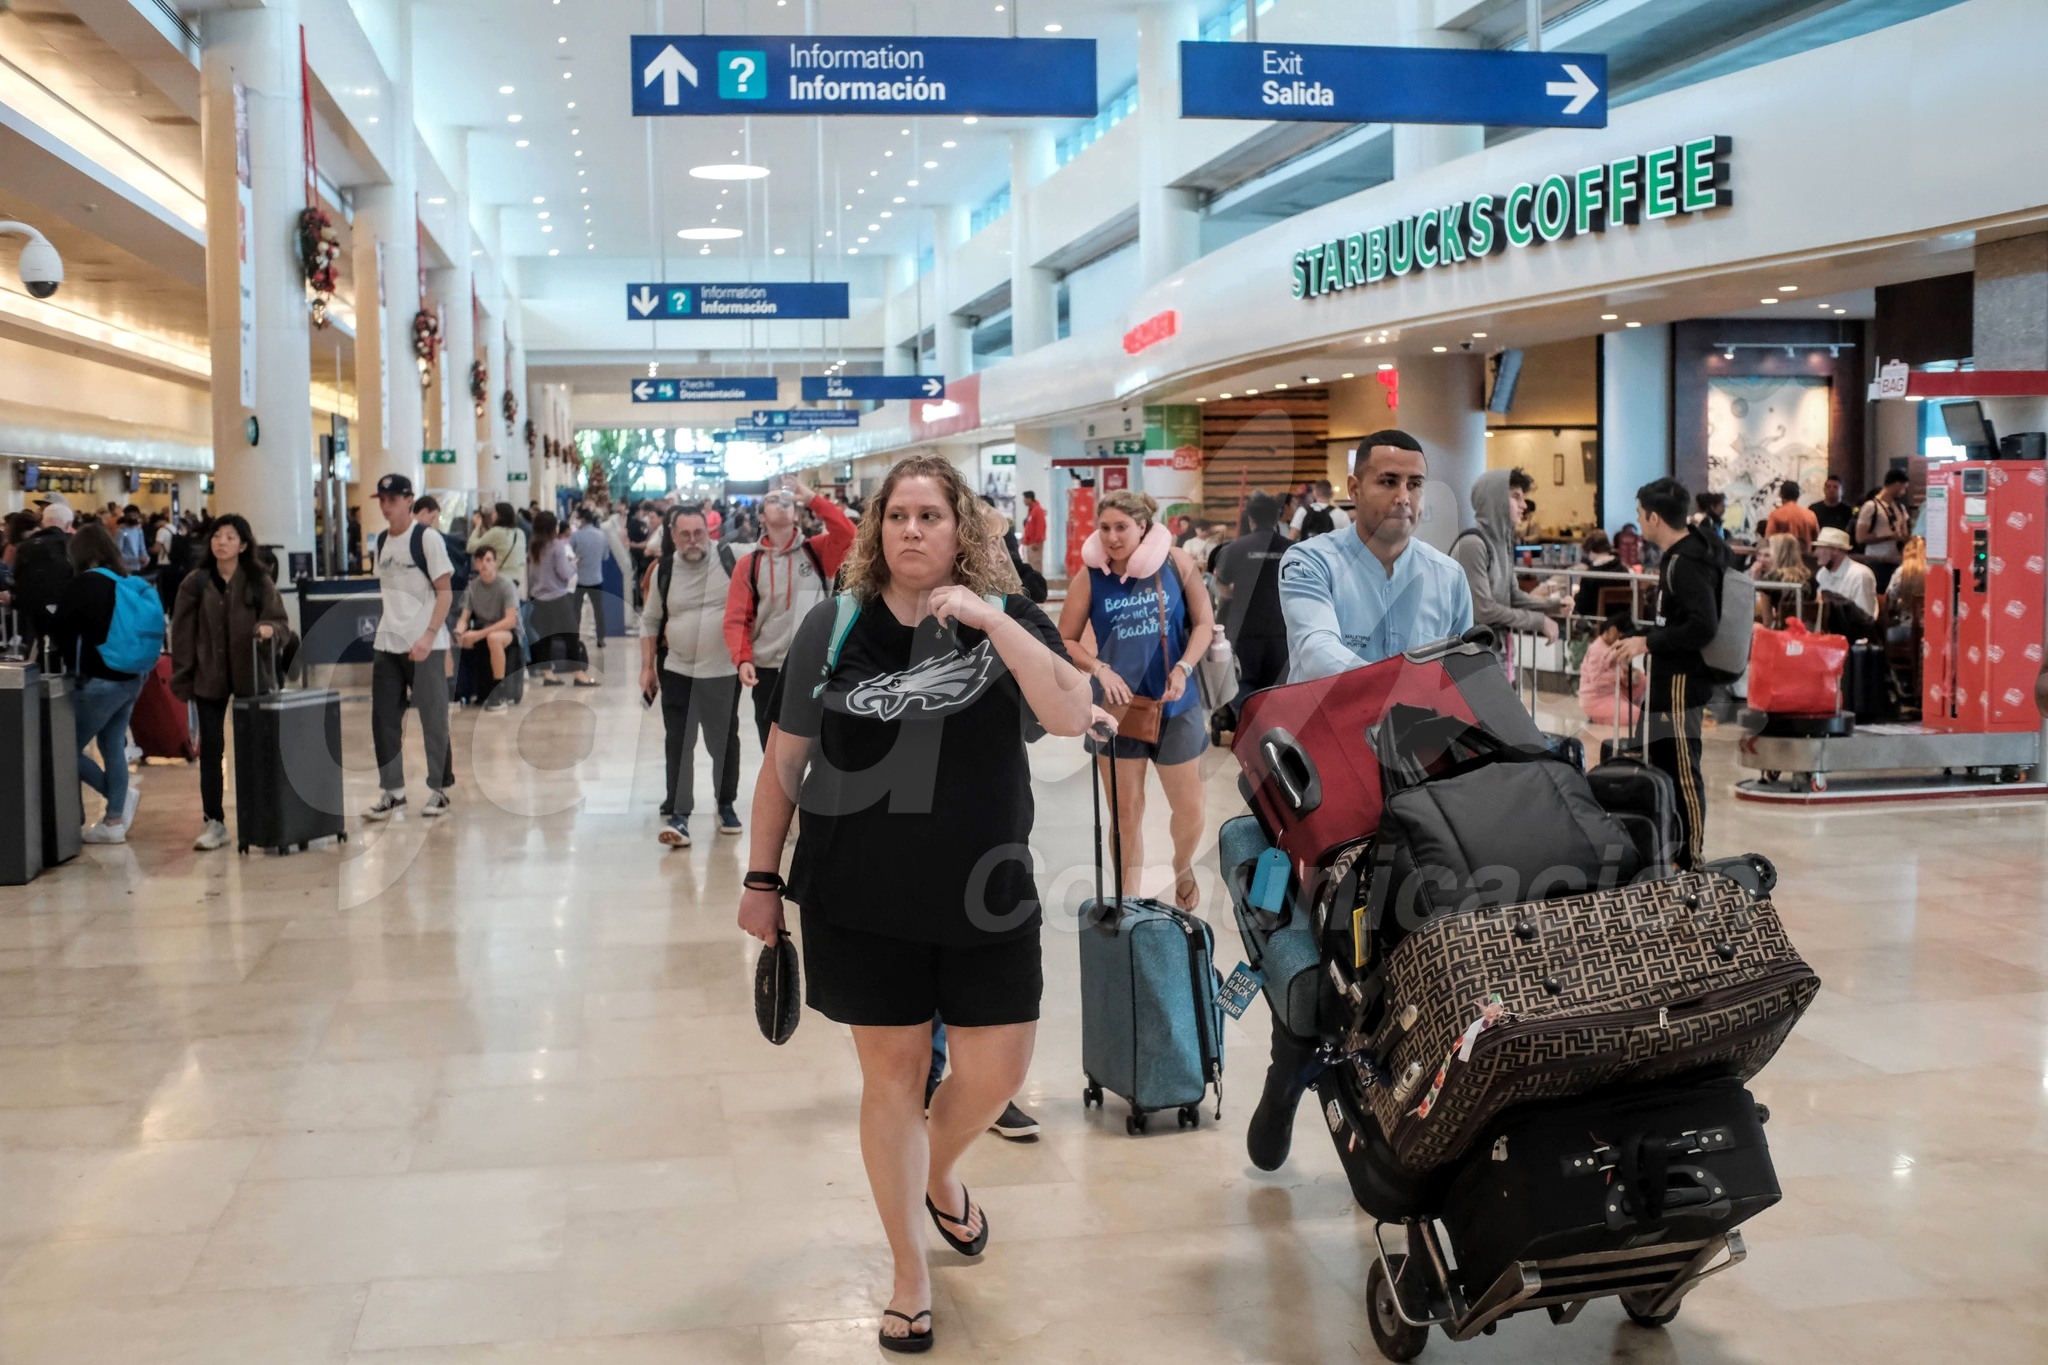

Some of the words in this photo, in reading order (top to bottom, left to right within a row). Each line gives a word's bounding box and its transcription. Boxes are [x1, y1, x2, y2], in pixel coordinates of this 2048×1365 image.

[790, 43, 925, 69] Information
[1262, 50, 1303, 75] Exit
[789, 74, 946, 101] Información
[1261, 80, 1335, 106] Salida
[1291, 193, 1497, 301] STARBUCKS
[1505, 134, 1719, 249] COFFEE
[701, 285, 767, 299] Information
[701, 300, 777, 314] Información
[1104, 590, 1170, 613] Beaching
[1227, 979, 1251, 1000] BACK
[1232, 971, 1250, 987] PUT
